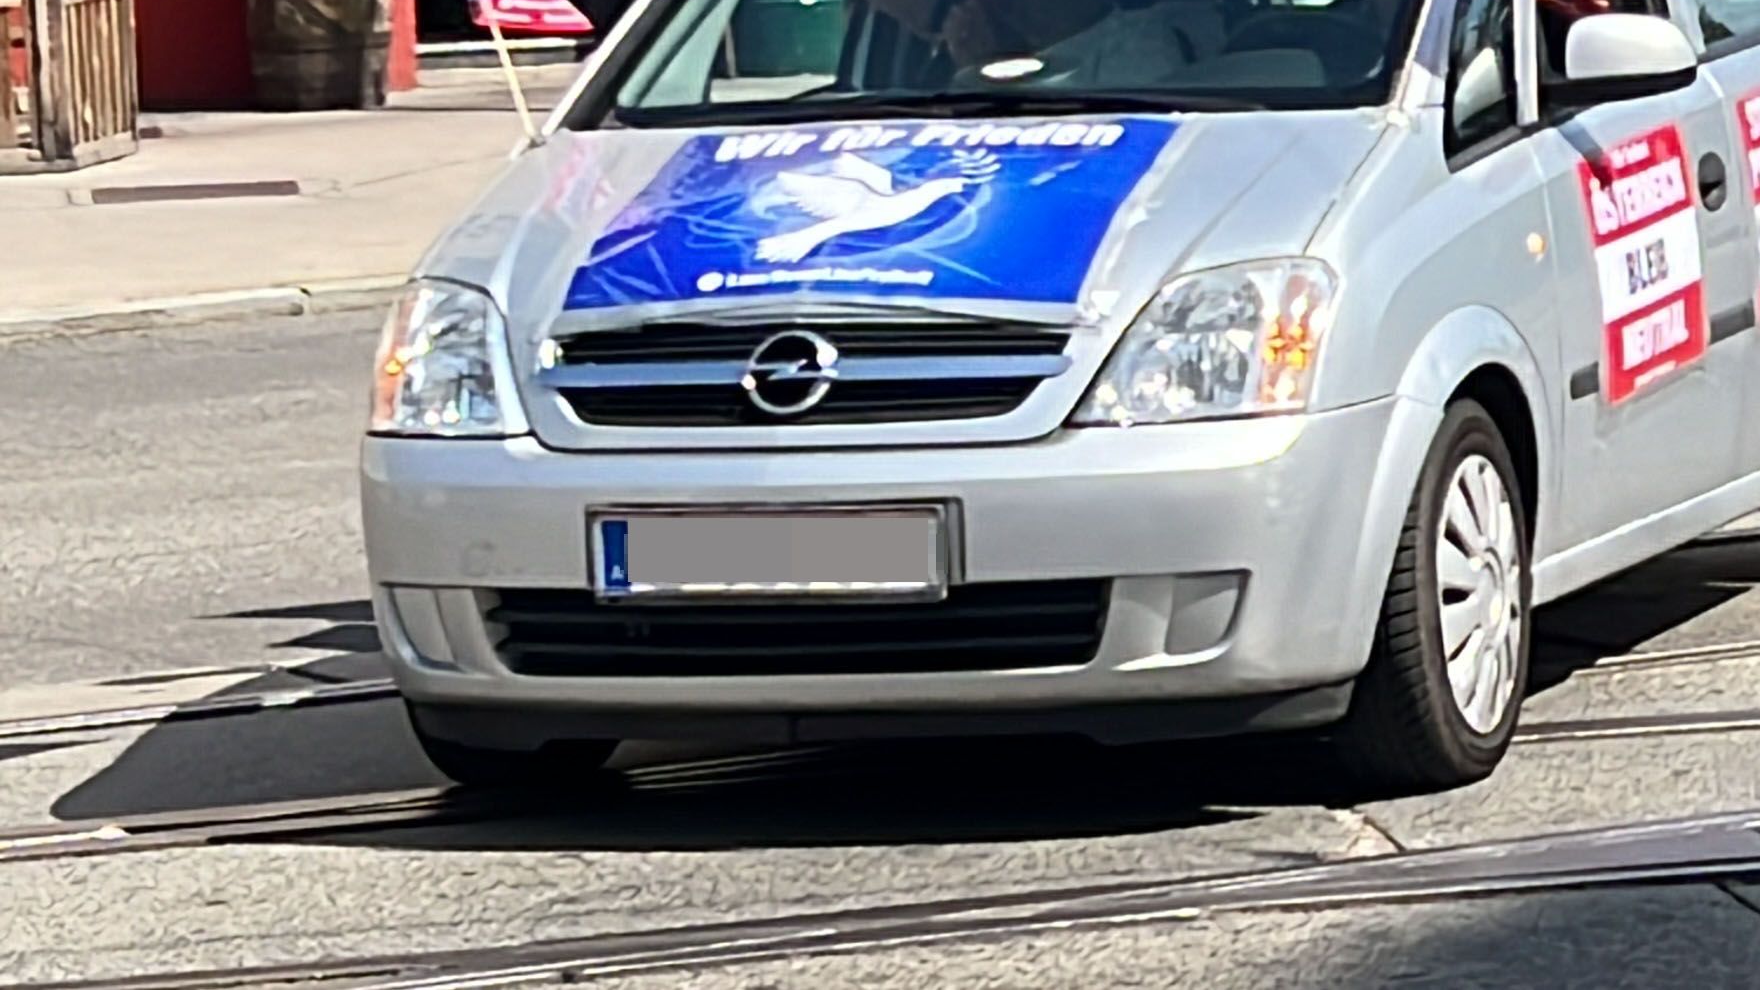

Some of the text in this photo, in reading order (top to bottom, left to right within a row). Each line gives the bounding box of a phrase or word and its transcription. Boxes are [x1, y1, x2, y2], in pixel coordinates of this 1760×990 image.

[714, 122, 1125, 163] Wir für Frieden
